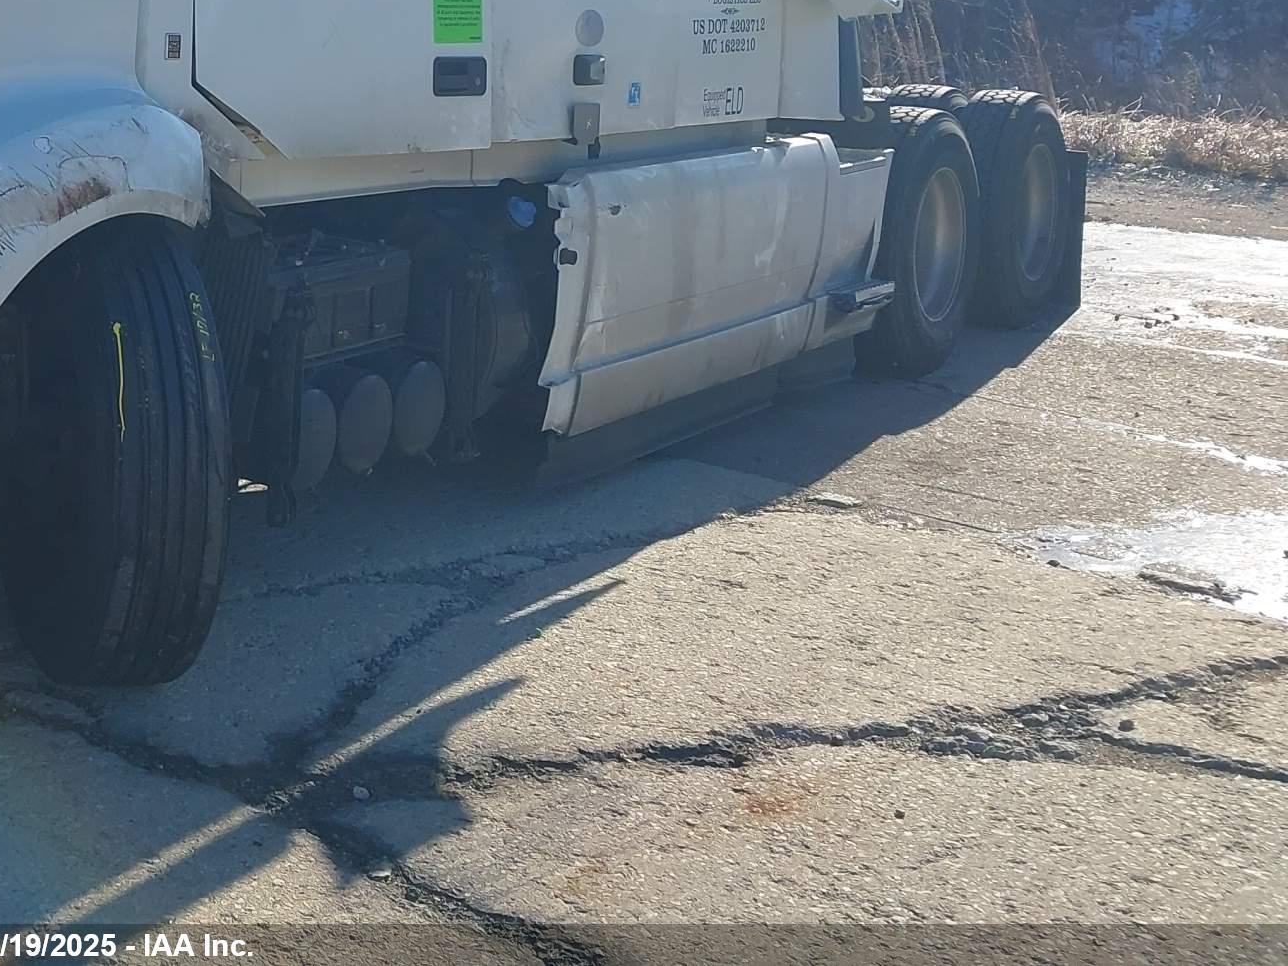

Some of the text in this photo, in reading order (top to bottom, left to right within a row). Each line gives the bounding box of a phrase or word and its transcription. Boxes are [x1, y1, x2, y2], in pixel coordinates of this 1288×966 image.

[693, 17, 766, 35] US DOT 4203712
[702, 37, 756, 55] MC 1622210
[725, 86, 744, 115] ELD
